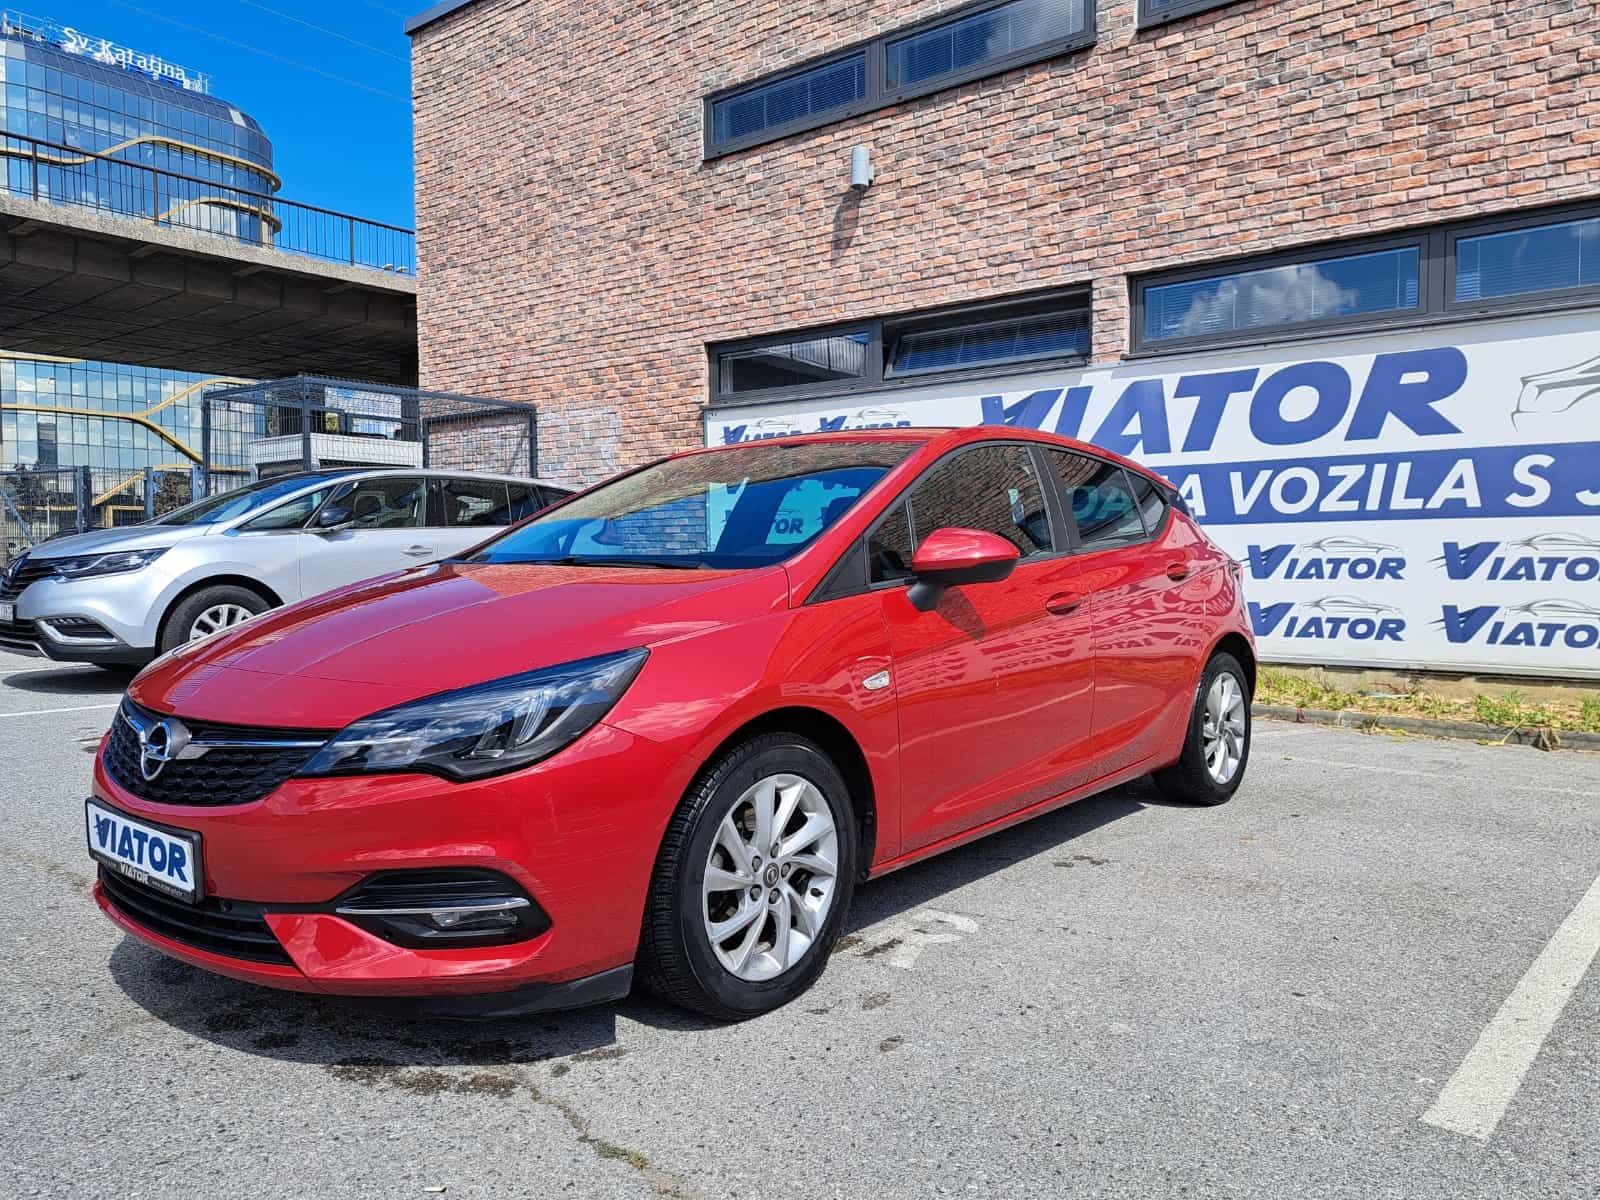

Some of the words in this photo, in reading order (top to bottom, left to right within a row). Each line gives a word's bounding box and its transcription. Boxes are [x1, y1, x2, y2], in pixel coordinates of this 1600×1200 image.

[1229, 459, 1482, 515] VOZILA
[1505, 454, 1555, 508] S
[1247, 543, 1407, 580] VIATOR
[1442, 541, 1600, 581] VIATO
[1247, 601, 1407, 641] VIATOR
[1441, 605, 1600, 649] VIATO
[95, 813, 188, 883] VIATOR
[120, 862, 150, 886] VIATOR
